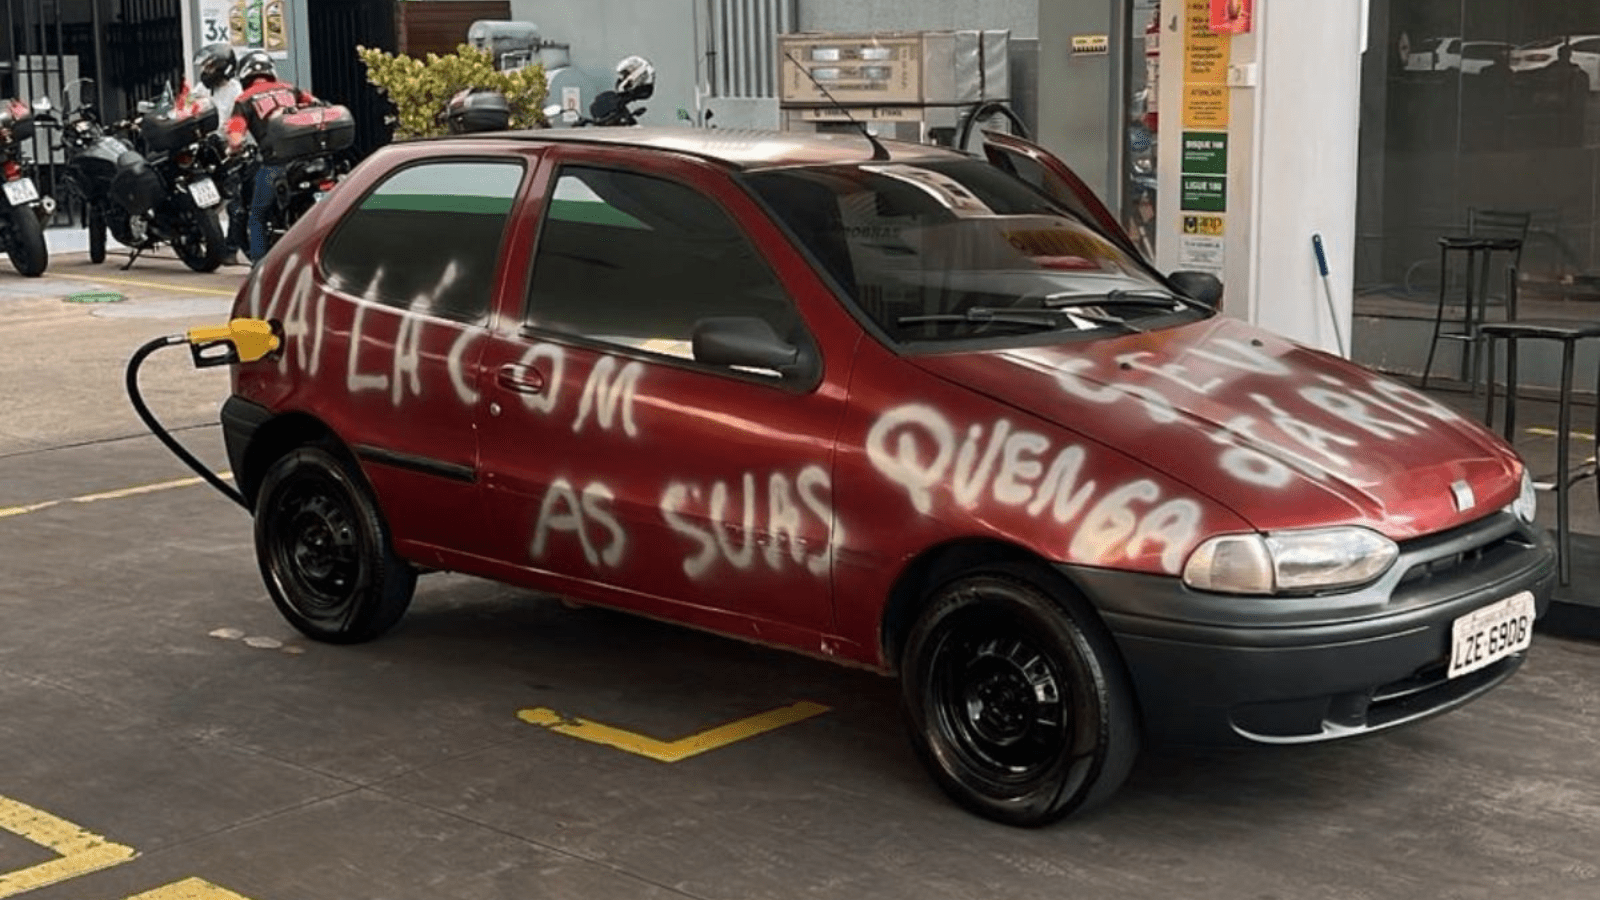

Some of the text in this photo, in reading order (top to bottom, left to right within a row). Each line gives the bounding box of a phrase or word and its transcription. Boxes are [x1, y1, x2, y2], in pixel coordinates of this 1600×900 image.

[204, 19, 228, 42] 3x
[529, 402, 1203, 579] AS SUAS QUENGA
[1453, 615, 1528, 670] LZE 6908
